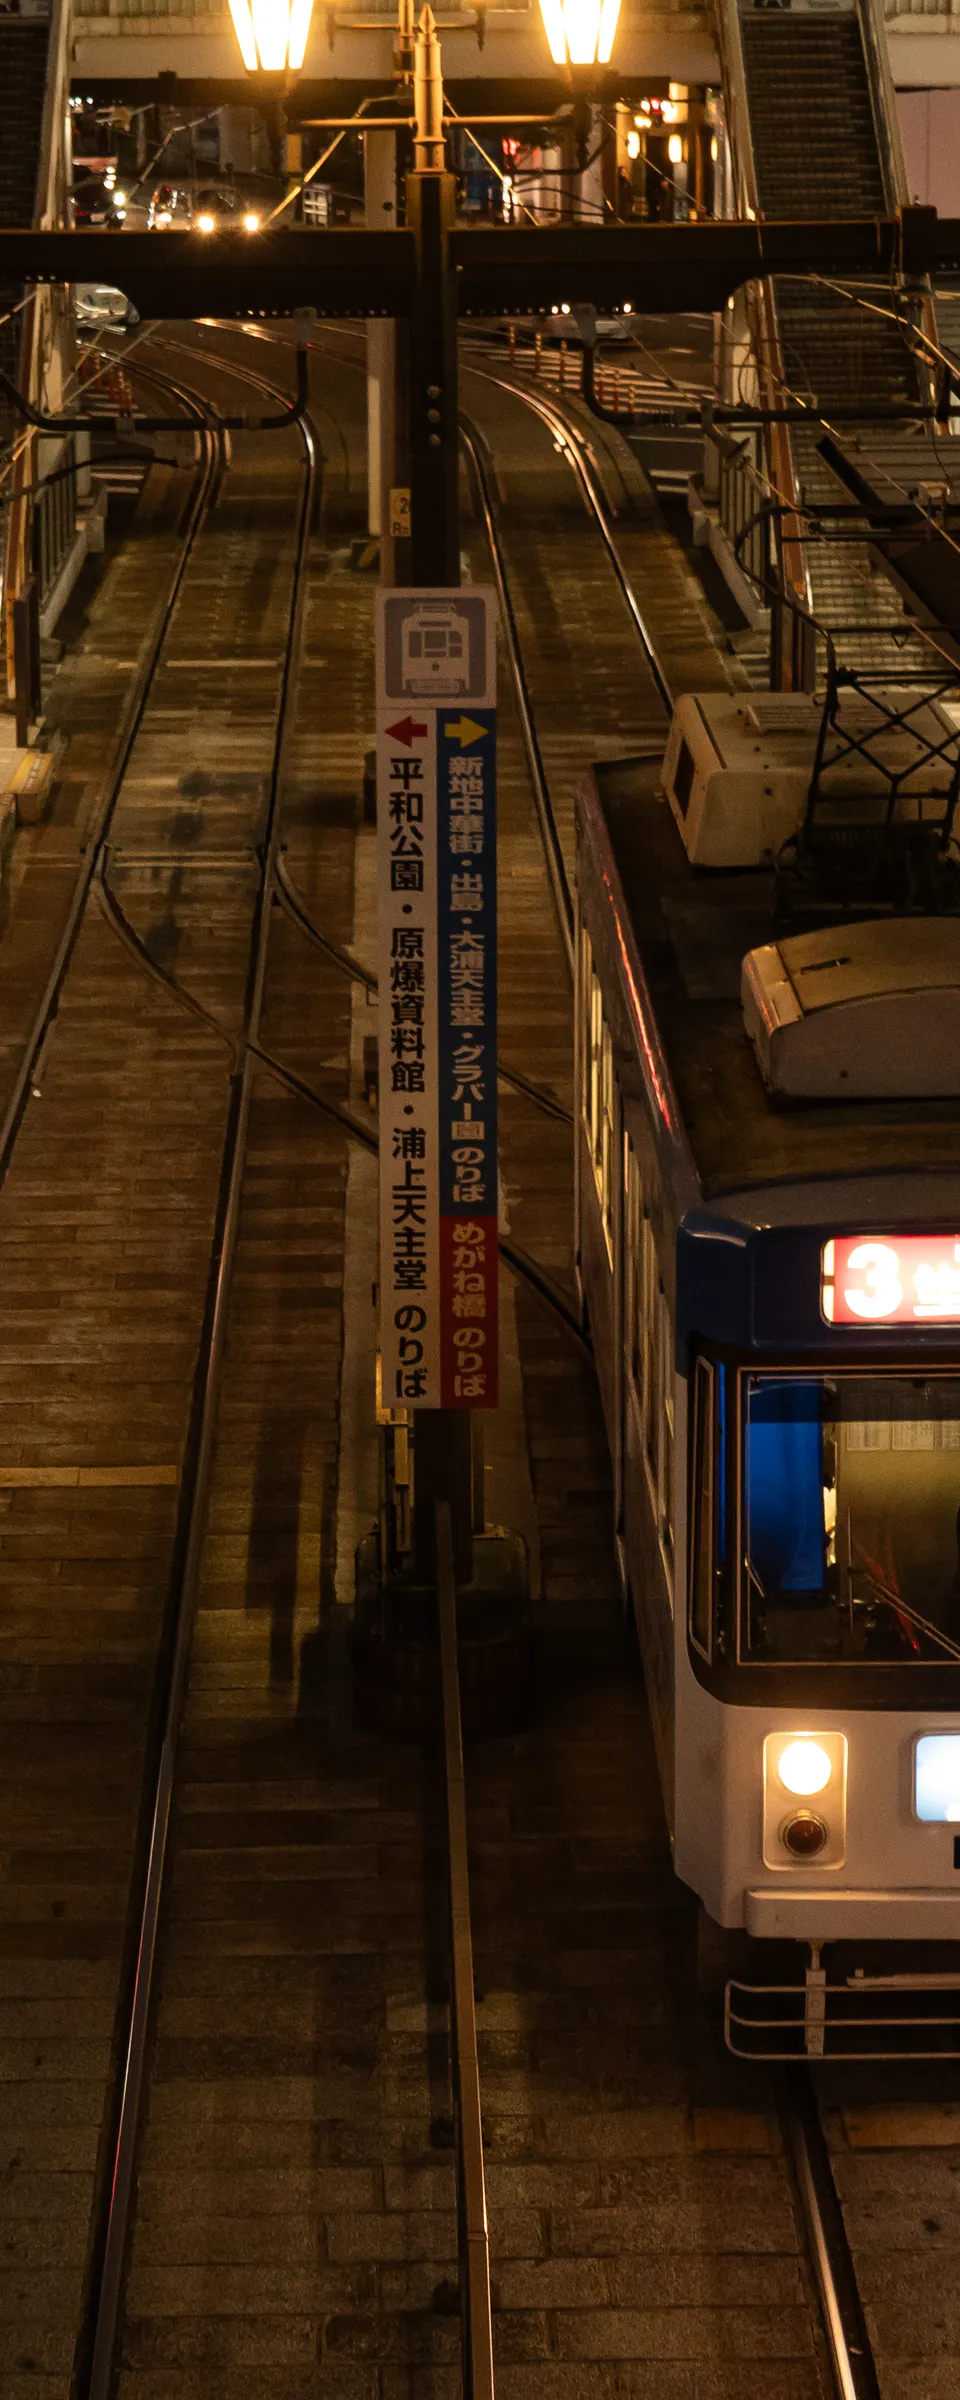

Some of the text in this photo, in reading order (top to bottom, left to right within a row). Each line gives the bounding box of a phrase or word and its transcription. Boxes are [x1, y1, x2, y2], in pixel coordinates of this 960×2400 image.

[451, 1147, 485, 1202] のりば
[452, 1223, 486, 1397] めがね橋 のりば
[844, 1243, 903, 1318] 3
[395, 1305, 428, 1398] のりば
